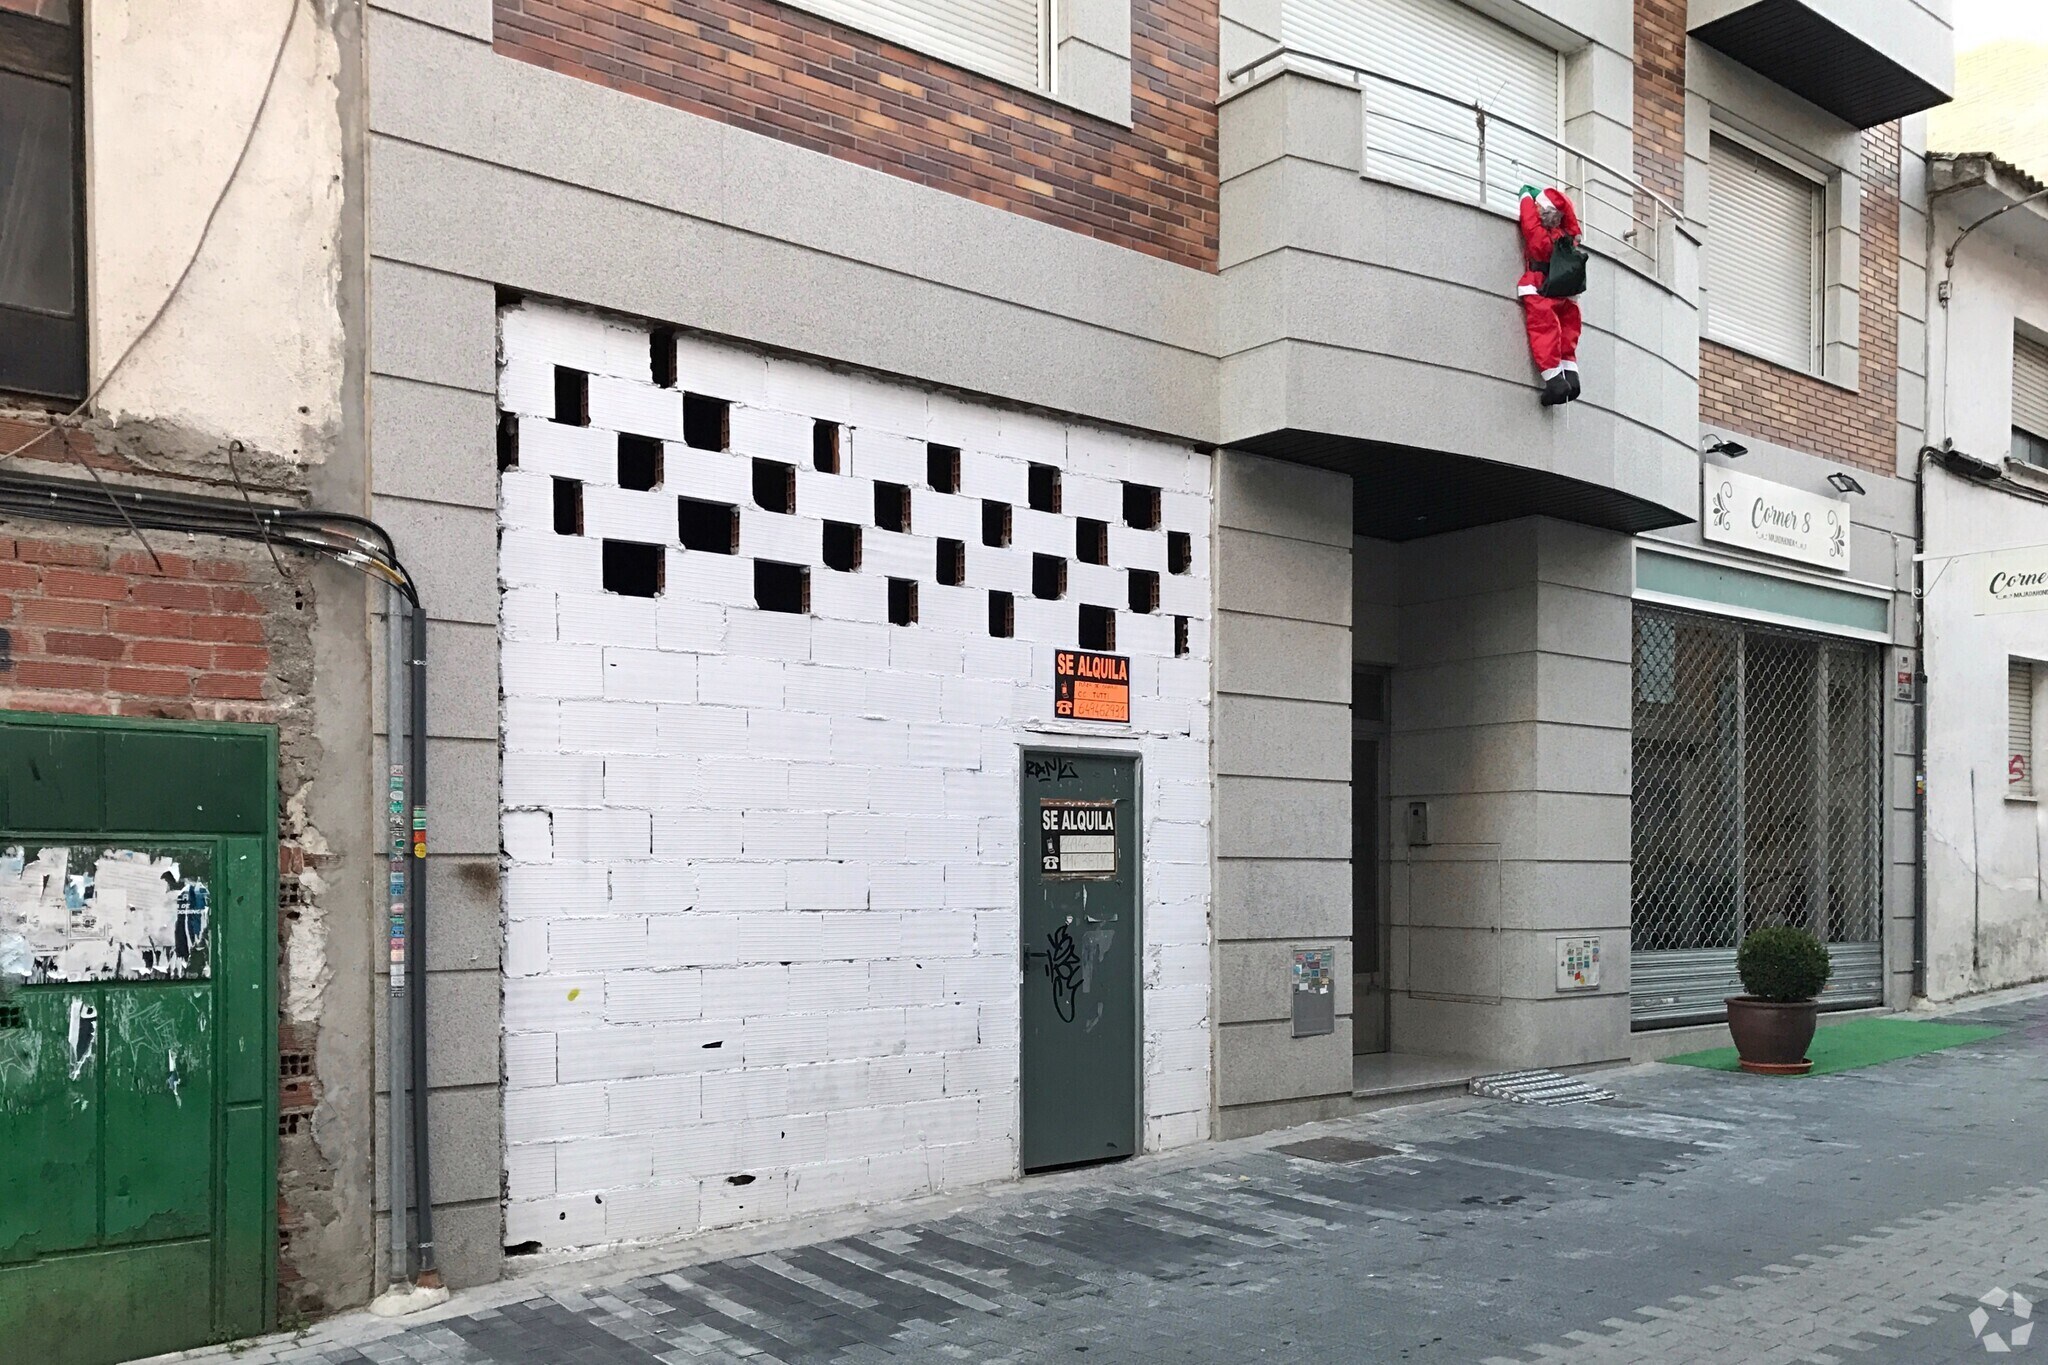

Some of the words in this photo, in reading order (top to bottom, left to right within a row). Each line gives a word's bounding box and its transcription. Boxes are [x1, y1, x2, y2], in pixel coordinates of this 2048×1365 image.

[1751, 497, 1797, 530] Corner
[1801, 511, 1811, 534] 8
[1989, 571, 2048, 594] Corne
[1057, 653, 1075, 676] SE
[1077, 655, 1128, 681] ALQUILA
[1042, 809, 1059, 831] SE
[1061, 810, 1114, 832] ALQUILA
